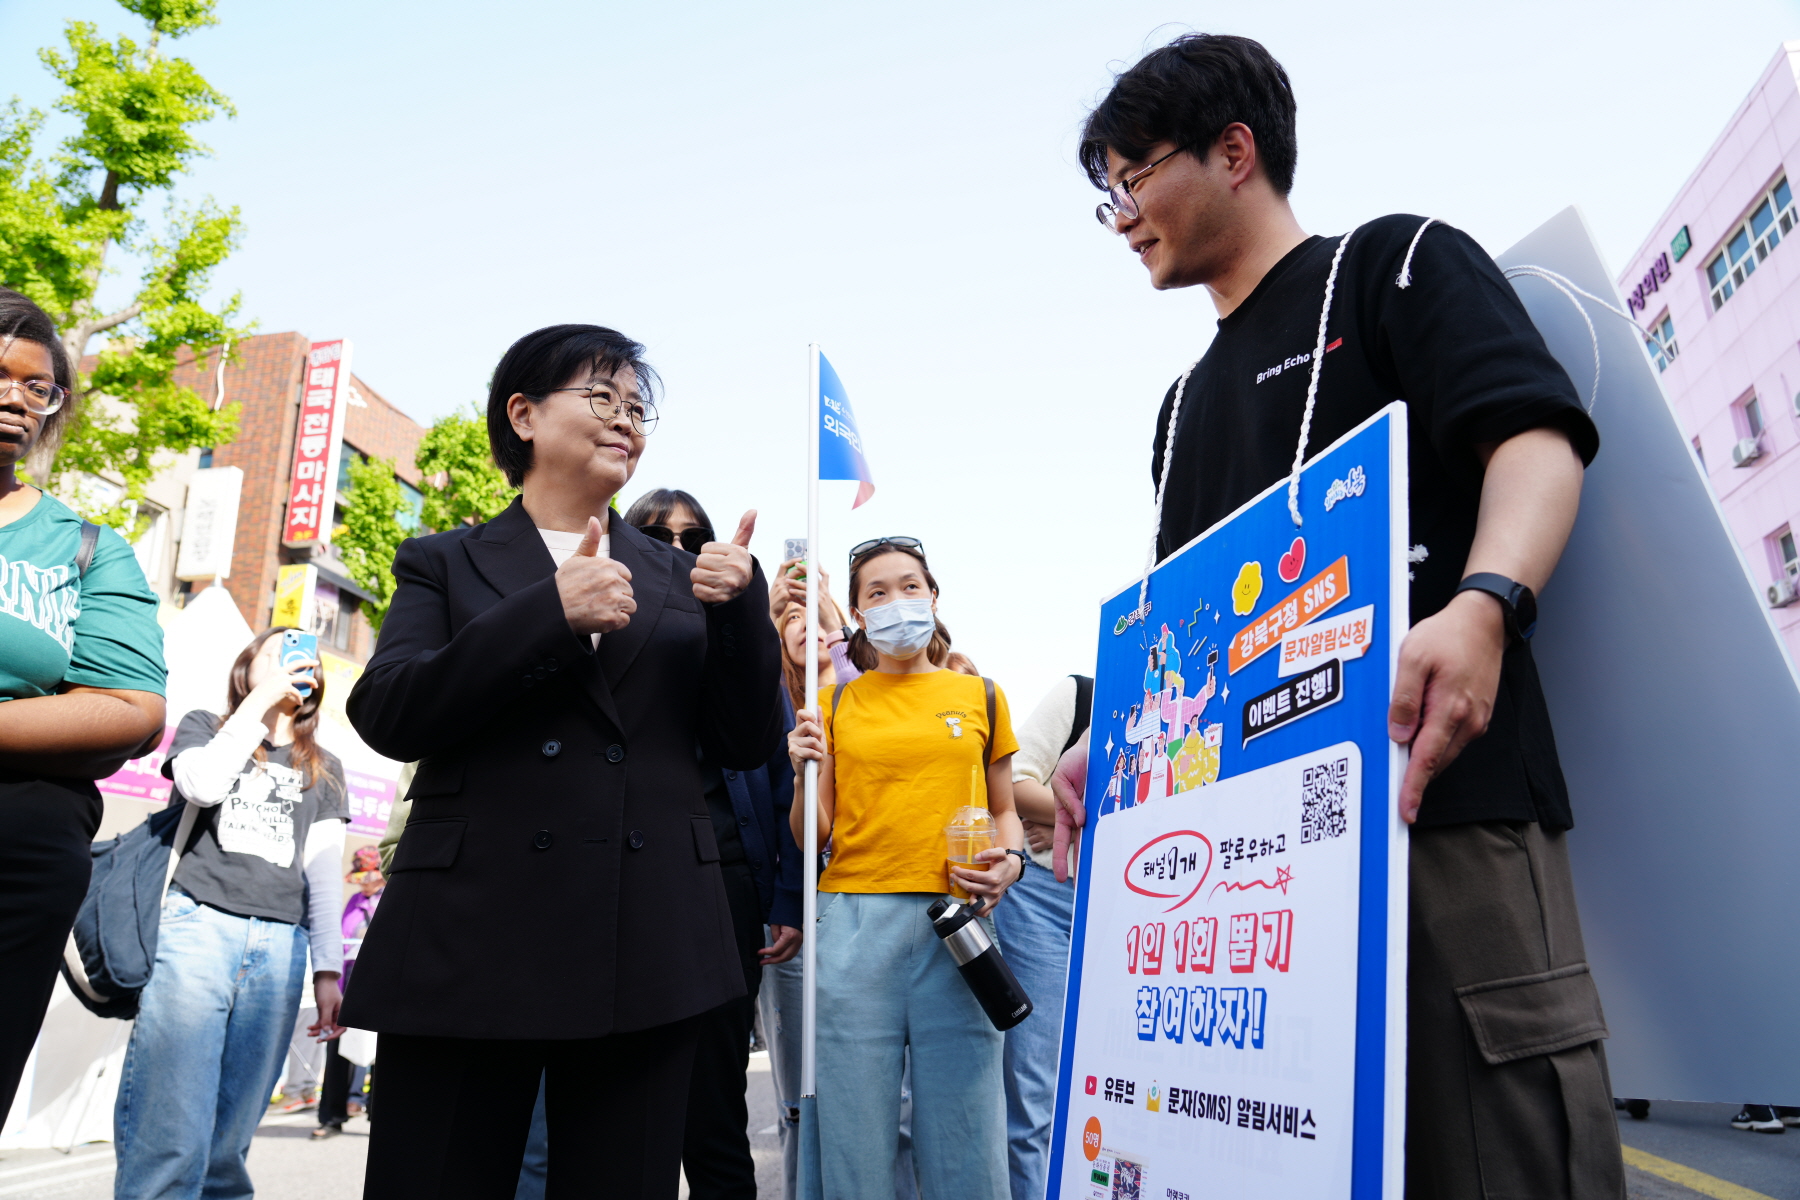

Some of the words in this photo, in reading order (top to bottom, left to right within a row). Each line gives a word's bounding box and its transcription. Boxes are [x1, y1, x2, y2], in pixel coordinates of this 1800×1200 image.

[1256, 364, 1282, 384] Bring
[1284, 353, 1311, 370] Echo
[1240, 596, 1299, 658] 강북구청
[1303, 572, 1337, 614] SNS
[1284, 618, 1368, 664] 문자알림신청
[935, 710, 967, 719] Peanuts
[1248, 690, 1291, 727] 이벤트
[1294, 666, 1333, 708] 진행!
[231, 797, 279, 813] PSYCHO
[1143, 846, 1197, 881] 채널1개
[1219, 833, 1287, 869] 팔로우하고
[1126, 922, 1165, 975] 1인
[1173, 916, 1218, 975] 1회
[1228, 909, 1294, 973] 뽑기
[1136, 985, 1268, 1050] 참여하자!
[1103, 1076, 1136, 1105] 유튜브
[1167, 1086, 1232, 1126] 문자(SMS)
[1236, 1097, 1317, 1141] 알림서비스
[1085, 1131, 1100, 1148] 50명
